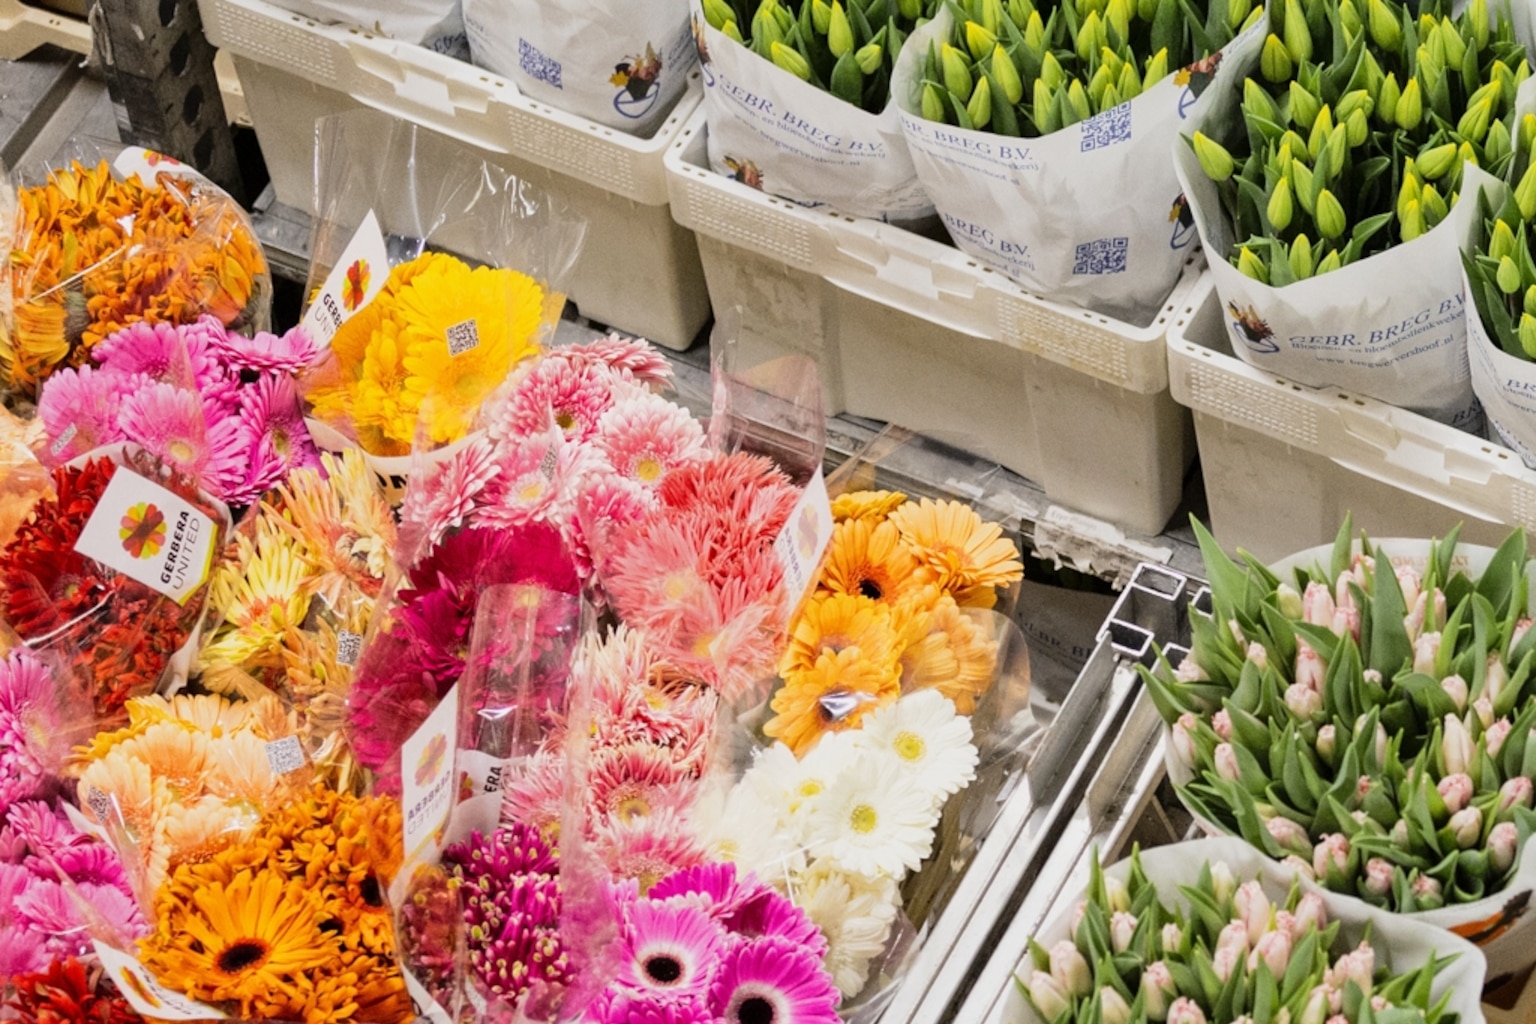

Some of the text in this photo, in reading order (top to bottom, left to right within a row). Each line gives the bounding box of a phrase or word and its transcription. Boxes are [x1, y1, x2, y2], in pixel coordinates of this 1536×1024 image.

[782, 110, 842, 148] BREG
[848, 140, 885, 153] B.V.
[934, 129, 992, 156] BREG
[999, 145, 1034, 161] B.V.
[944, 212, 1032, 258] BREG B.V.
[1369, 308, 1431, 344] BREG
[160, 510, 190, 584] GERBERA
[173, 517, 200, 590] UNITED
